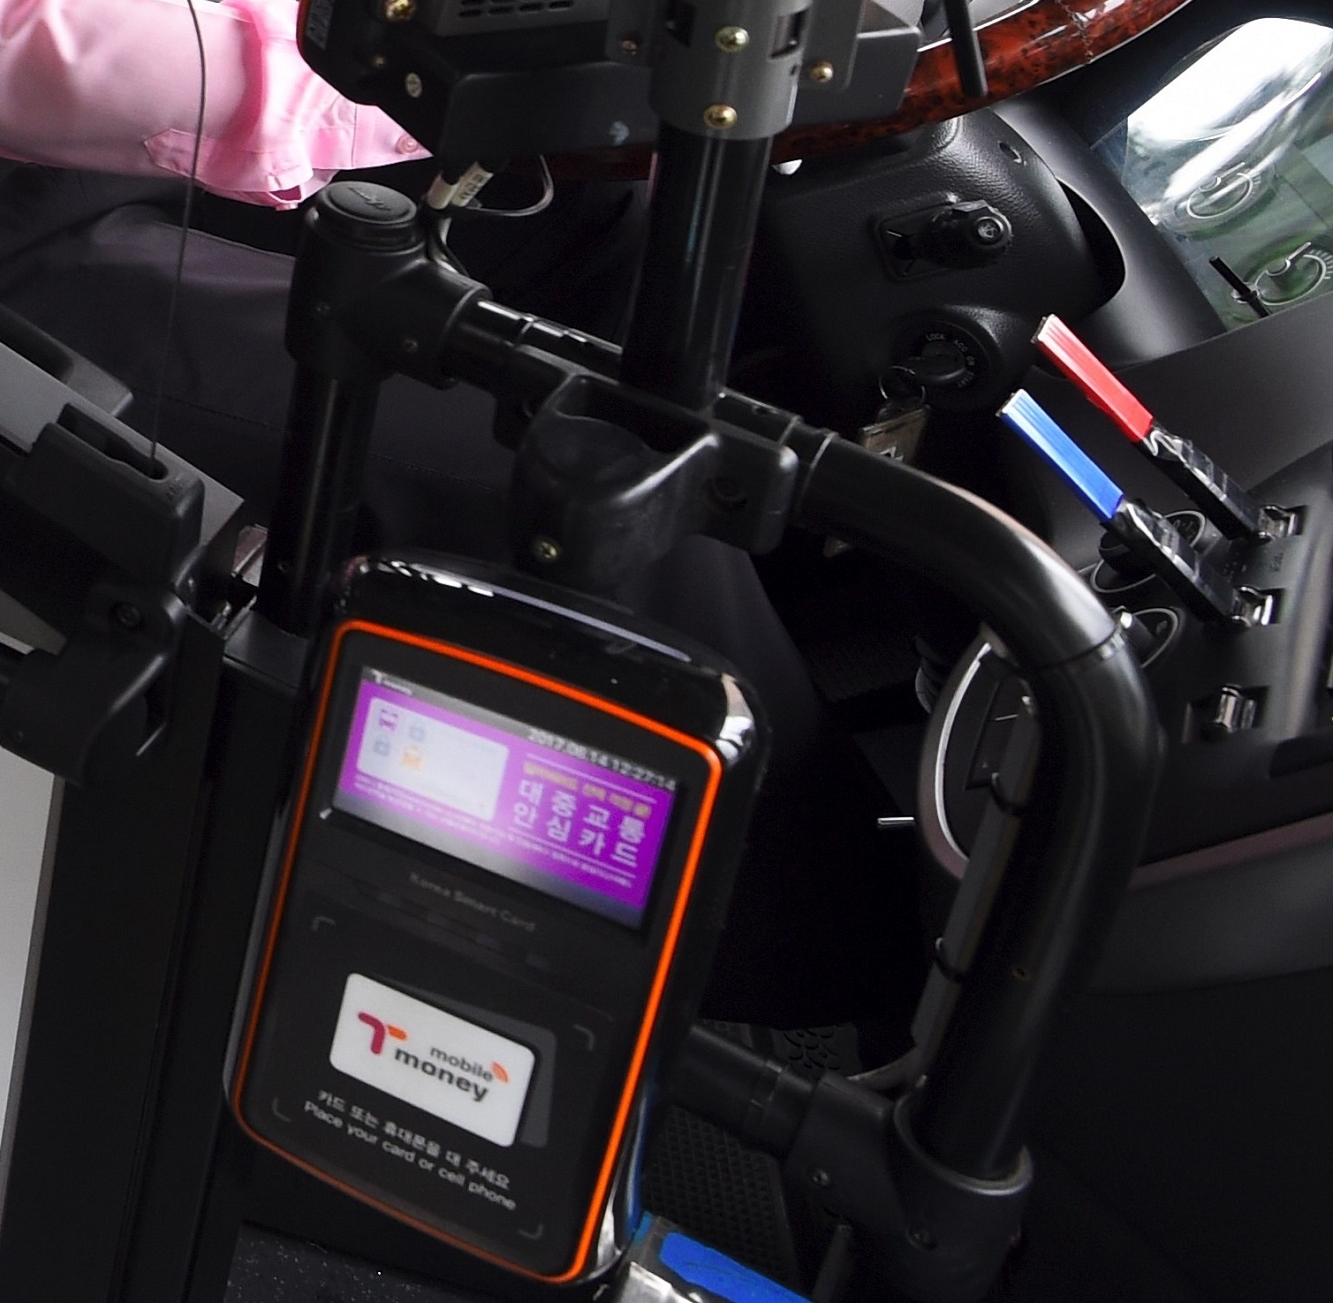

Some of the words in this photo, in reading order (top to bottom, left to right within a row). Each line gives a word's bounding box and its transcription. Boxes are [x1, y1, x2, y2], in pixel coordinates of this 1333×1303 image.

[925, 332, 946, 342] LOCK
[513, 802, 638, 868] 안심카드
[518, 779, 646, 845] 대중교통
[499, 907, 537, 932] Card
[394, 1047, 490, 1103] money
[430, 1046, 494, 1083] mobile
[303, 1099, 344, 1129] Place
[346, 1123, 379, 1145] your
[381, 1140, 416, 1164] card
[417, 1156, 436, 1172] or
[437, 1165, 466, 1187] cell
[468, 1181, 517, 1212] phone
[318, 1089, 346, 1113] 카드
[349, 1104, 380, 1129] 또는
[445, 1149, 462, 1168] 대
[465, 1158, 511, 1191] 주세요
